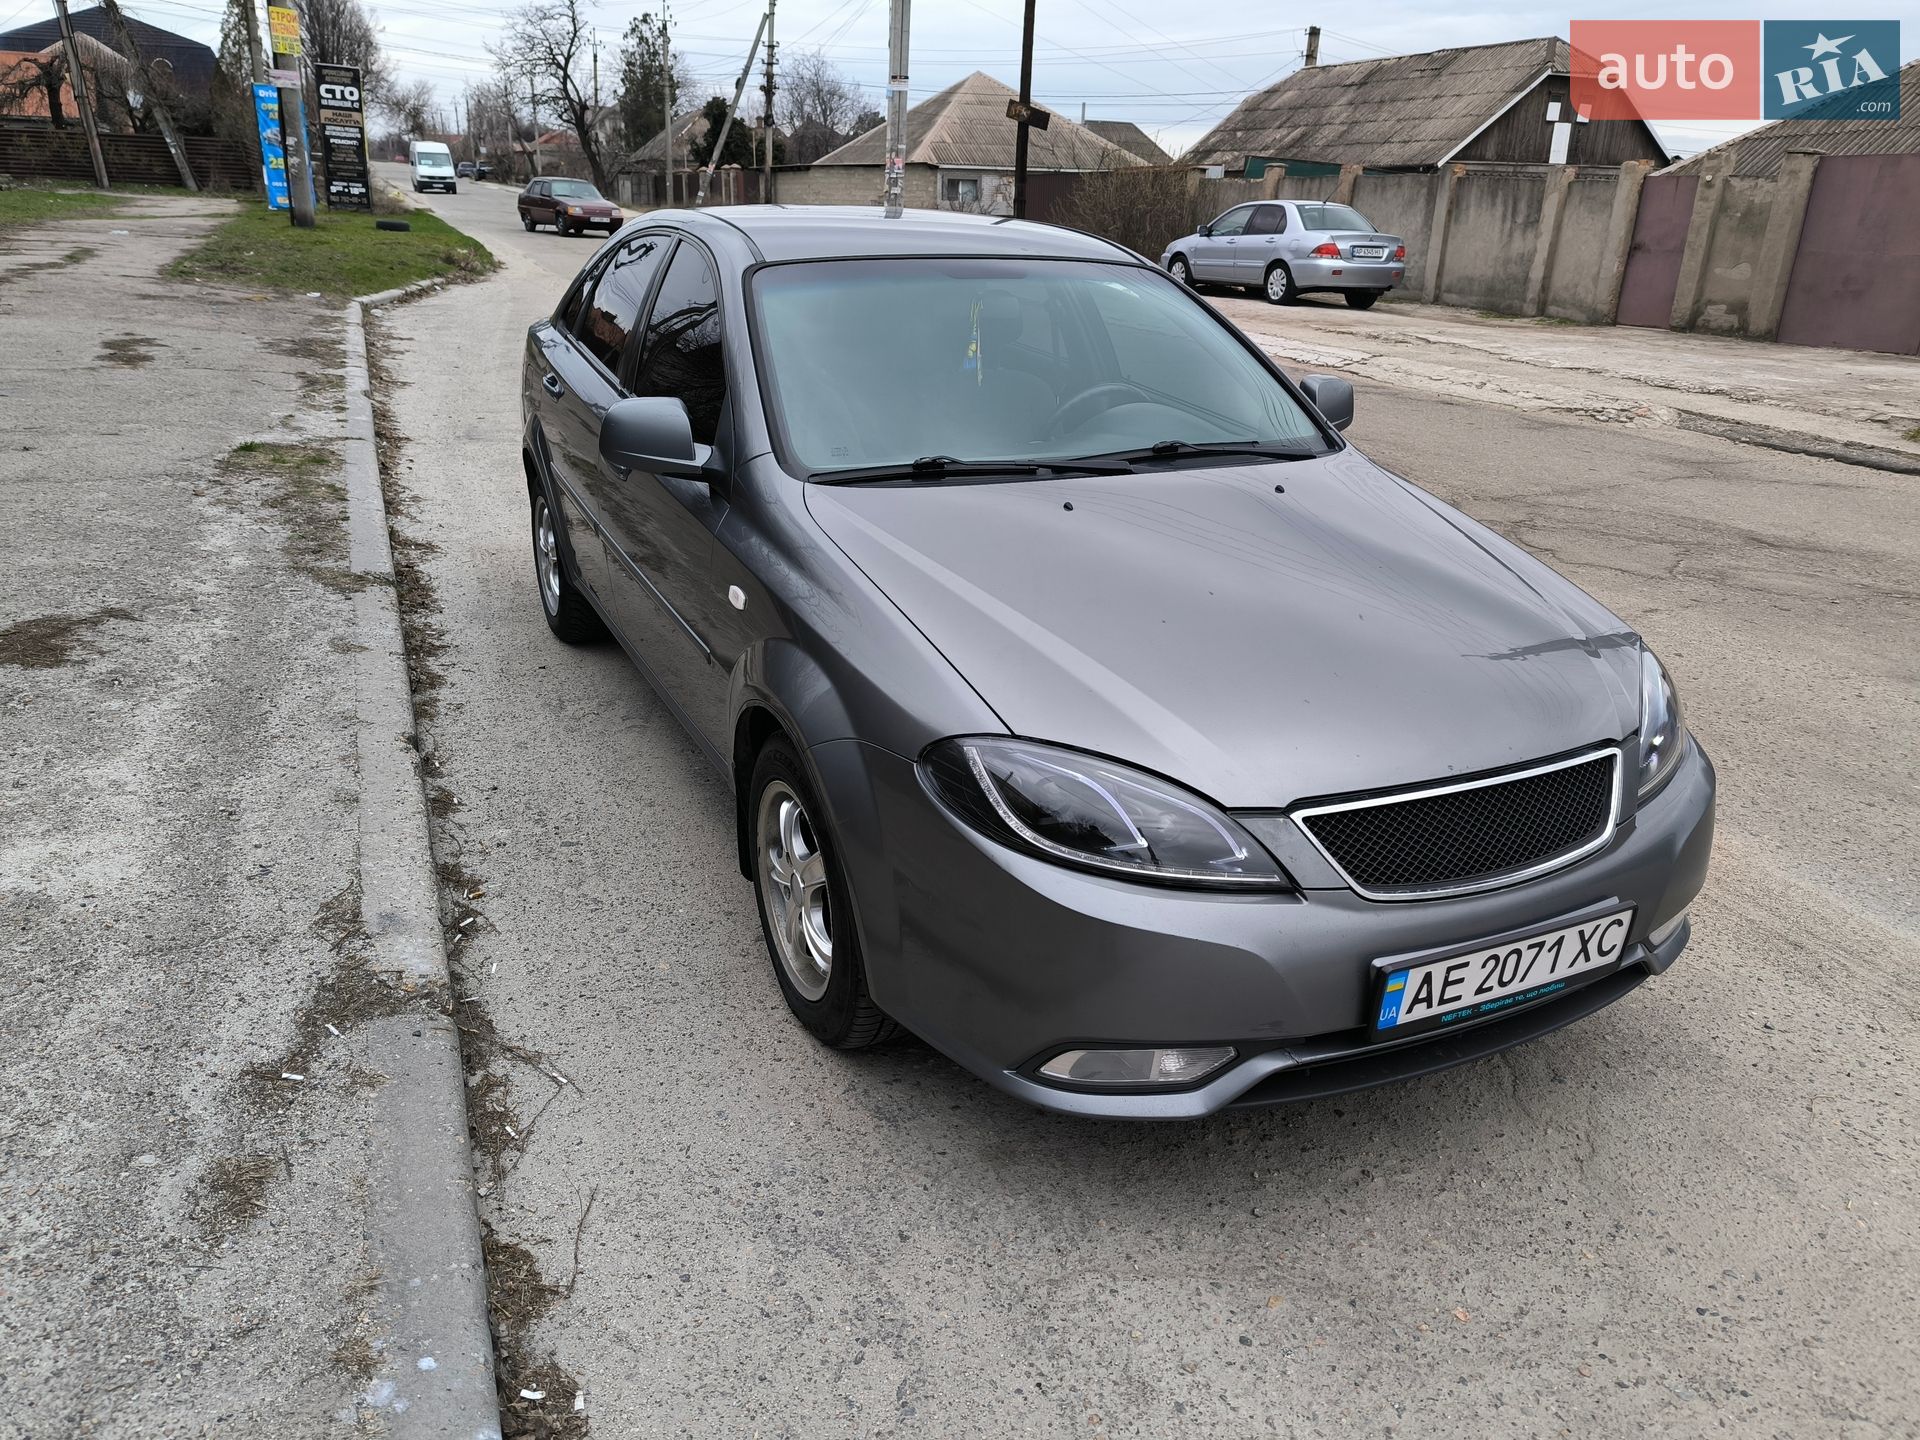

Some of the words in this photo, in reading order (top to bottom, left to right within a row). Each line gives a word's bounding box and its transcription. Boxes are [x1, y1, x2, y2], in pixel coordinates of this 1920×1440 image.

[320, 84, 359, 101] СТО
[1405, 961, 1471, 1015] AE
[1474, 935, 1565, 997] 2071
[1568, 918, 1624, 969] XC
[1379, 1007, 1398, 1022] UA
[1441, 1008, 1473, 1022] NEFTEK
